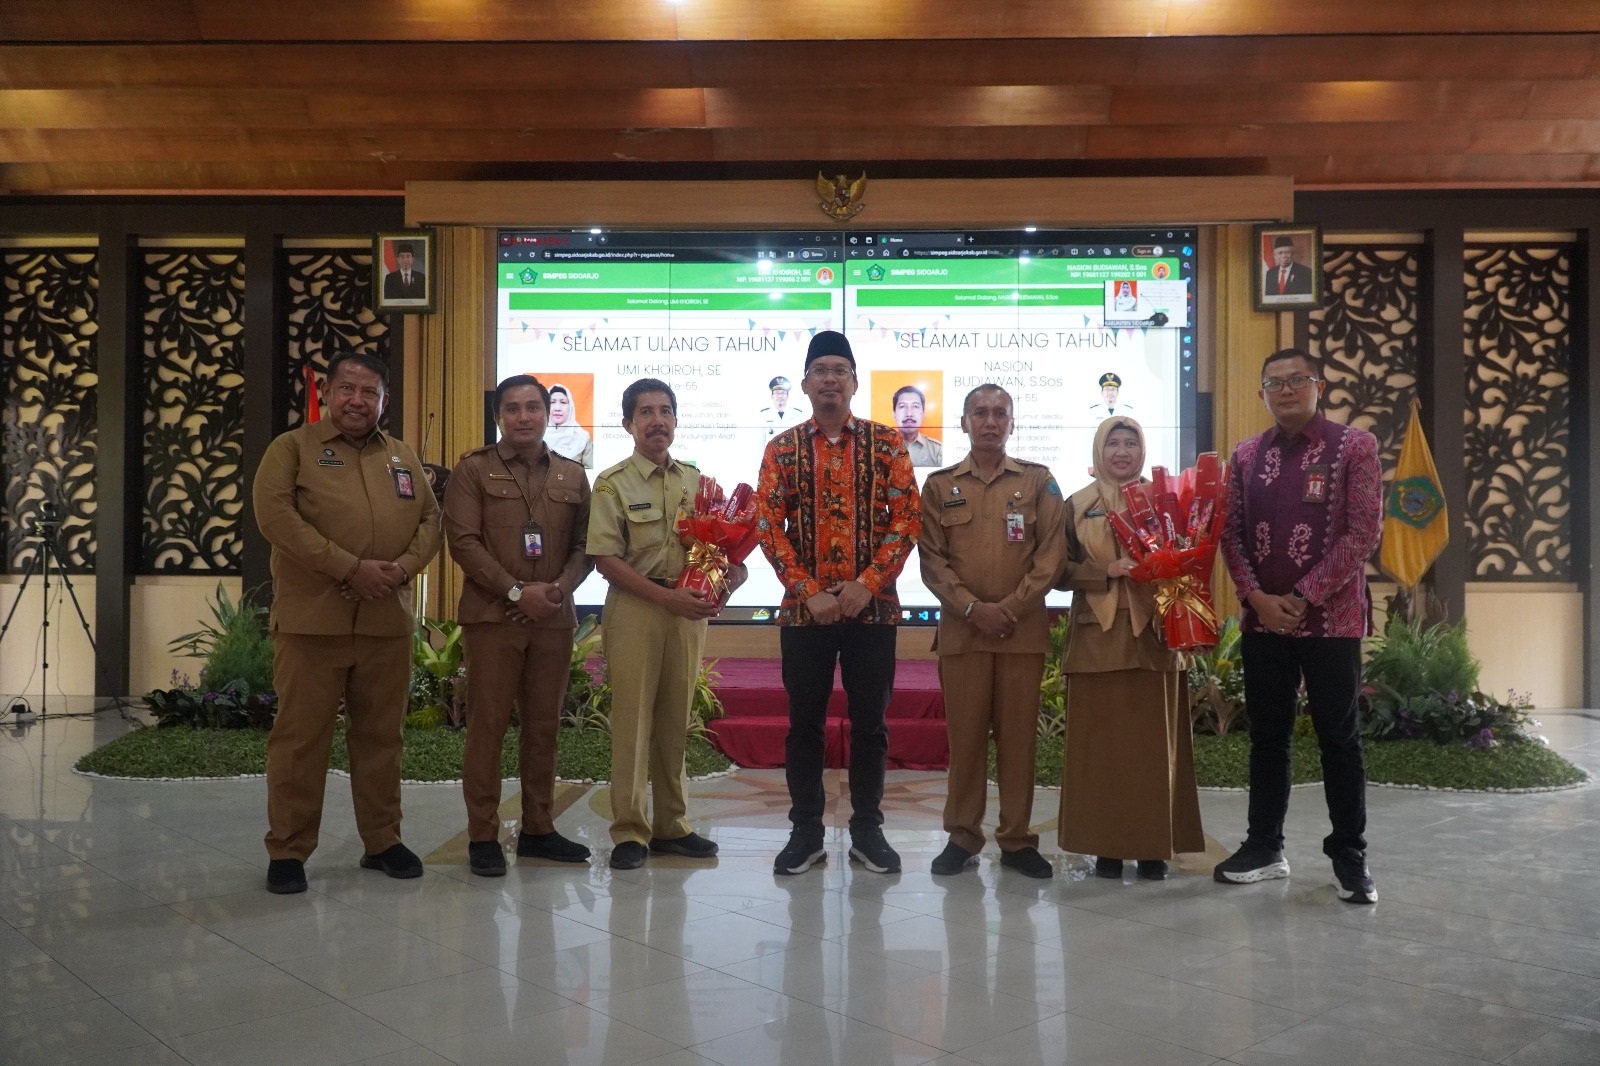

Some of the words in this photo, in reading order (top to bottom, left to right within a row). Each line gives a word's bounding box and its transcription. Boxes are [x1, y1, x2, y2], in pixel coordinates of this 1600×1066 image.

[563, 336, 641, 352] SELAMAT
[649, 336, 709, 352] ULANG
[716, 336, 776, 352] TAHUN
[901, 333, 980, 348] SELAMAT
[988, 333, 1048, 348] ULANG
[1056, 333, 1117, 348] TAHUN
[617, 365, 640, 375] UMI
[645, 364, 703, 377] KHOIROH,
[707, 364, 721, 375] SE
[984, 361, 1032, 372] NASION
[954, 376, 1026, 388] BUDIAWAN,
[1030, 376, 1063, 387] S.Sos
